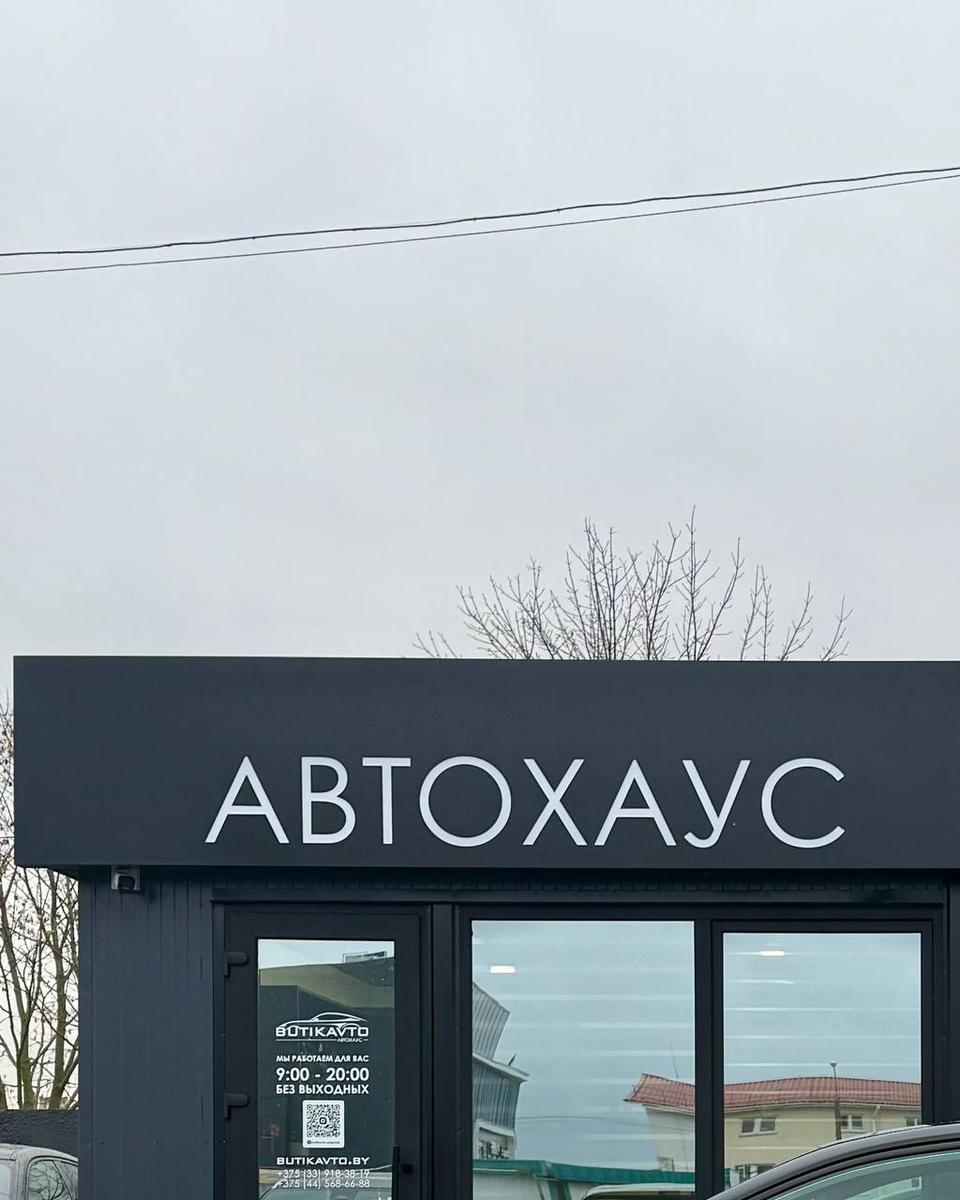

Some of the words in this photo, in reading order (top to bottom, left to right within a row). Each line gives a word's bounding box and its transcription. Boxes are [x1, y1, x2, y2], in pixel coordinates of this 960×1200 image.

[205, 755, 846, 849] АВТОХАУС
[275, 1026, 369, 1037] BUTIKAVTO
[334, 1055, 351, 1063] ДЛЯ
[276, 1067, 310, 1082] 9:00
[326, 1067, 370, 1082] 20:00
[276, 1084, 296, 1095] БЕЗ
[299, 1084, 370, 1096] ВЫХОДНЫХ
[276, 1157, 370, 1166] BUTIKAVTO.BY
[278, 1169, 300, 1178] +375
[303, 1169, 321, 1179] (33)
[324, 1169, 370, 1178] 918-38-19
[303, 1179, 321, 1189] (44)
[324, 1179, 370, 1188] 568-66-88
